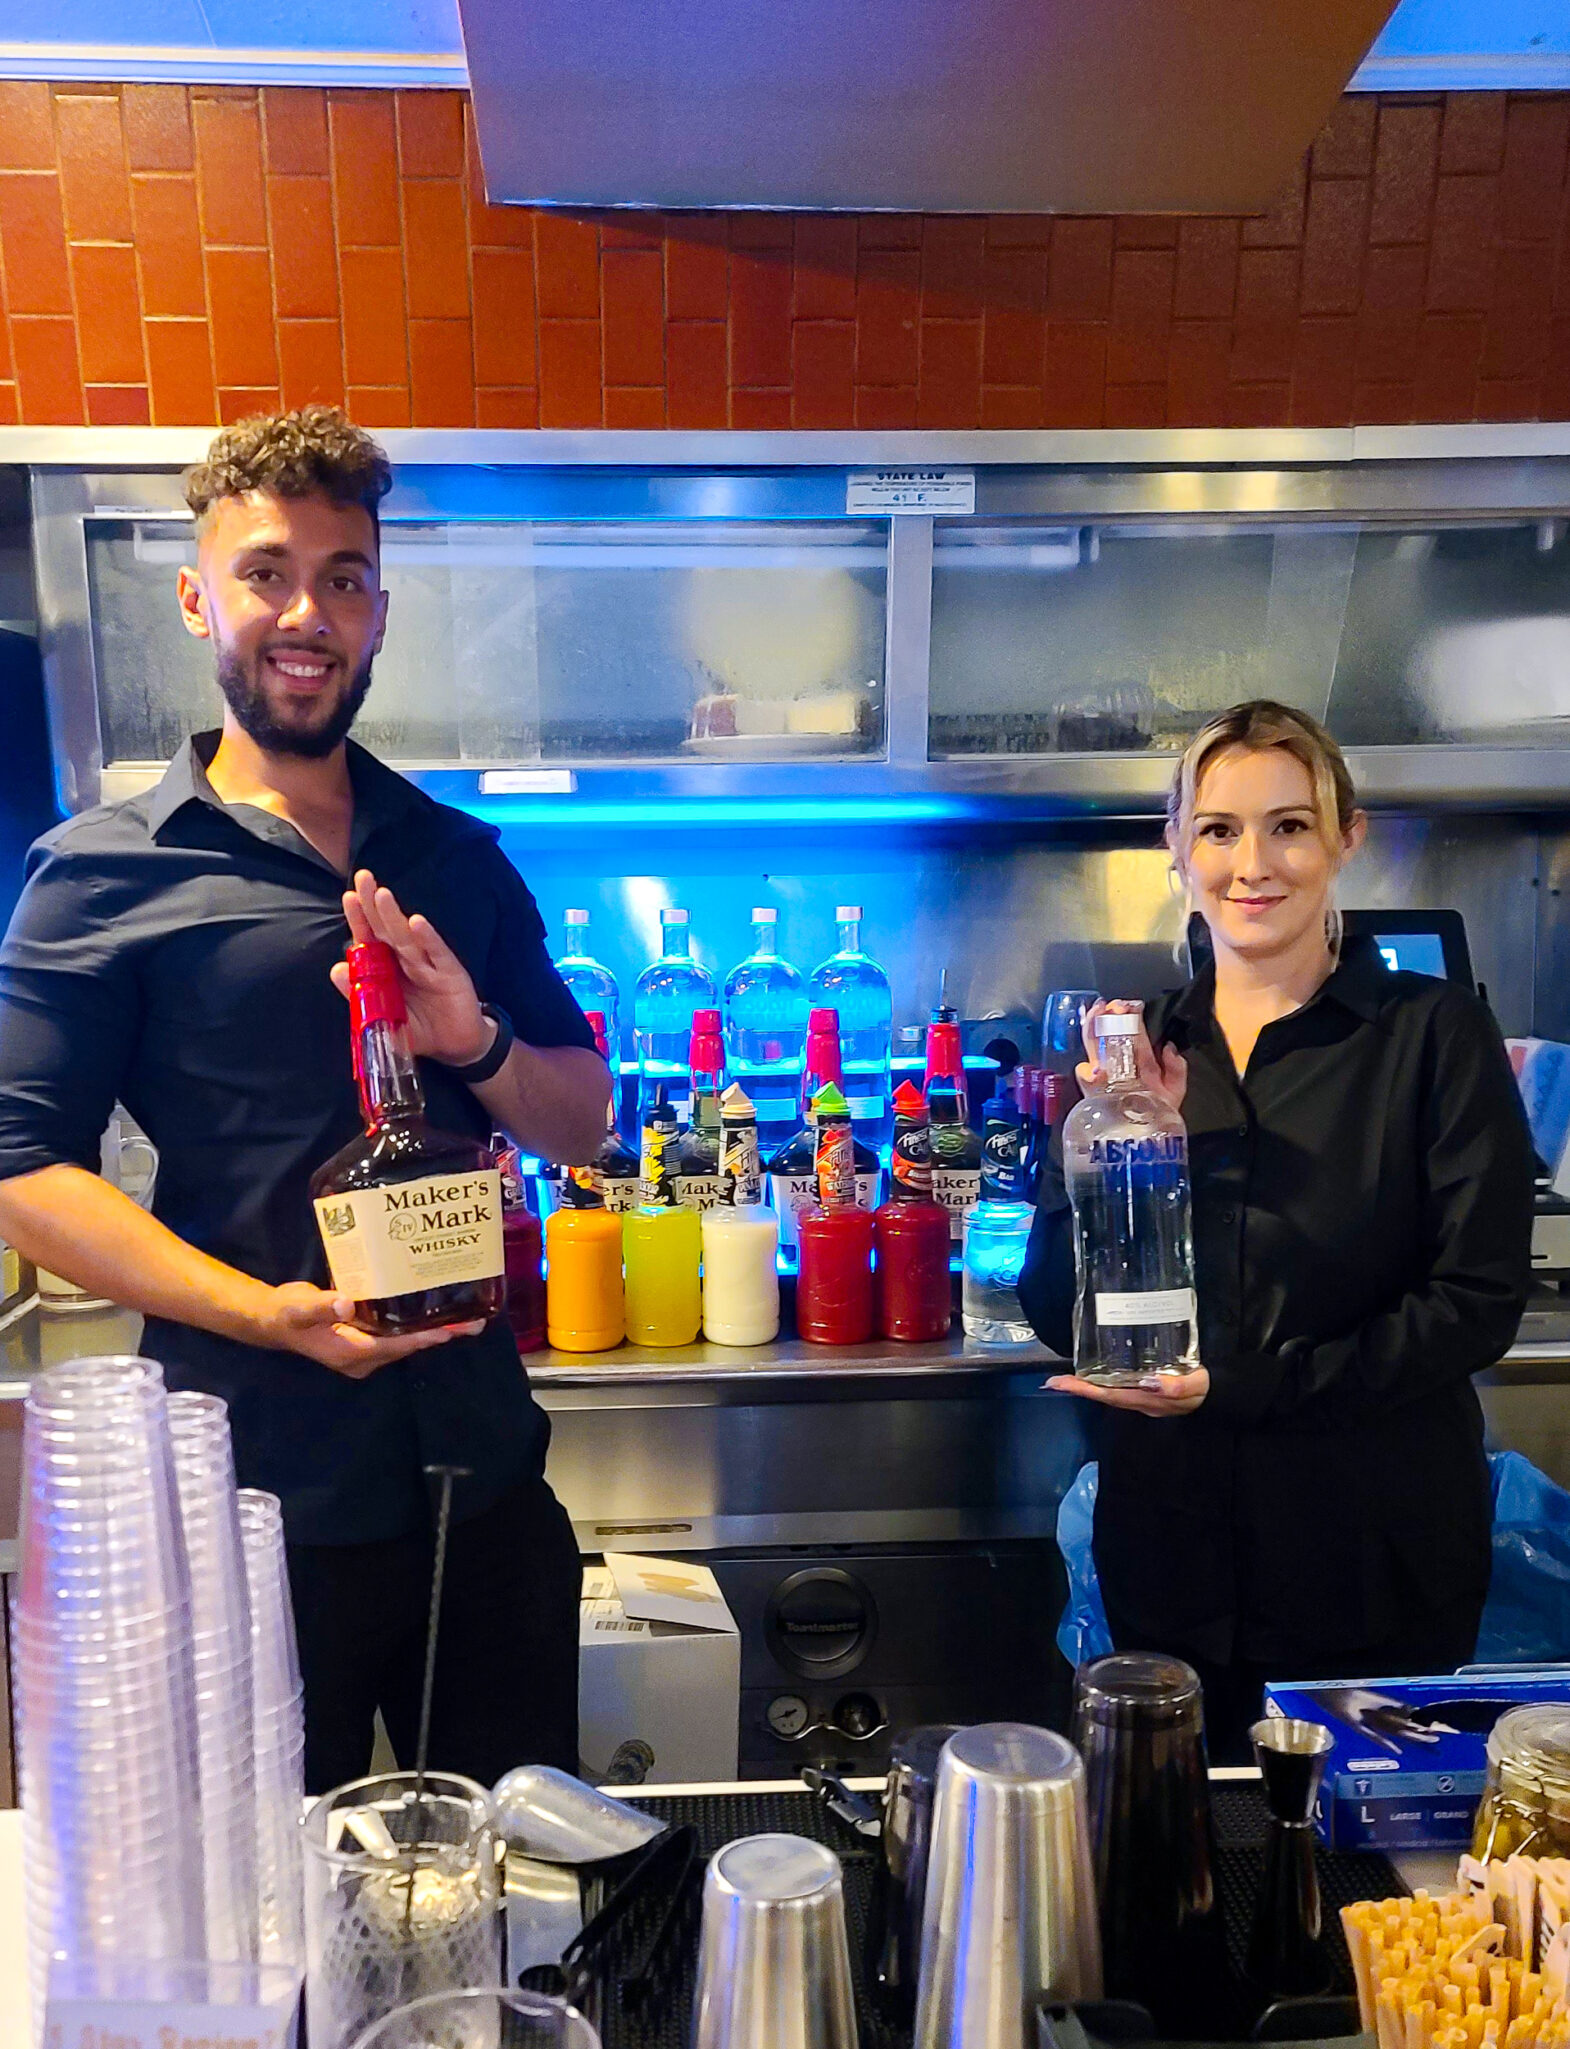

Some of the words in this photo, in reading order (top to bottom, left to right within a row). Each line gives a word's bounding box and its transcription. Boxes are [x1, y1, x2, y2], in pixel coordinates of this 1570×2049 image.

[877, 472, 914, 480] STATE
[919, 472, 946, 480] LAW
[1089, 1136, 1183, 1163] ABSOLUT
[384, 1180, 489, 1212] Maker's
[421, 1204, 492, 1232] Mark
[408, 1233, 482, 1255] WHISKY
[1361, 1806, 1375, 1823] L
[1390, 1811, 1422, 1821] LARGE
